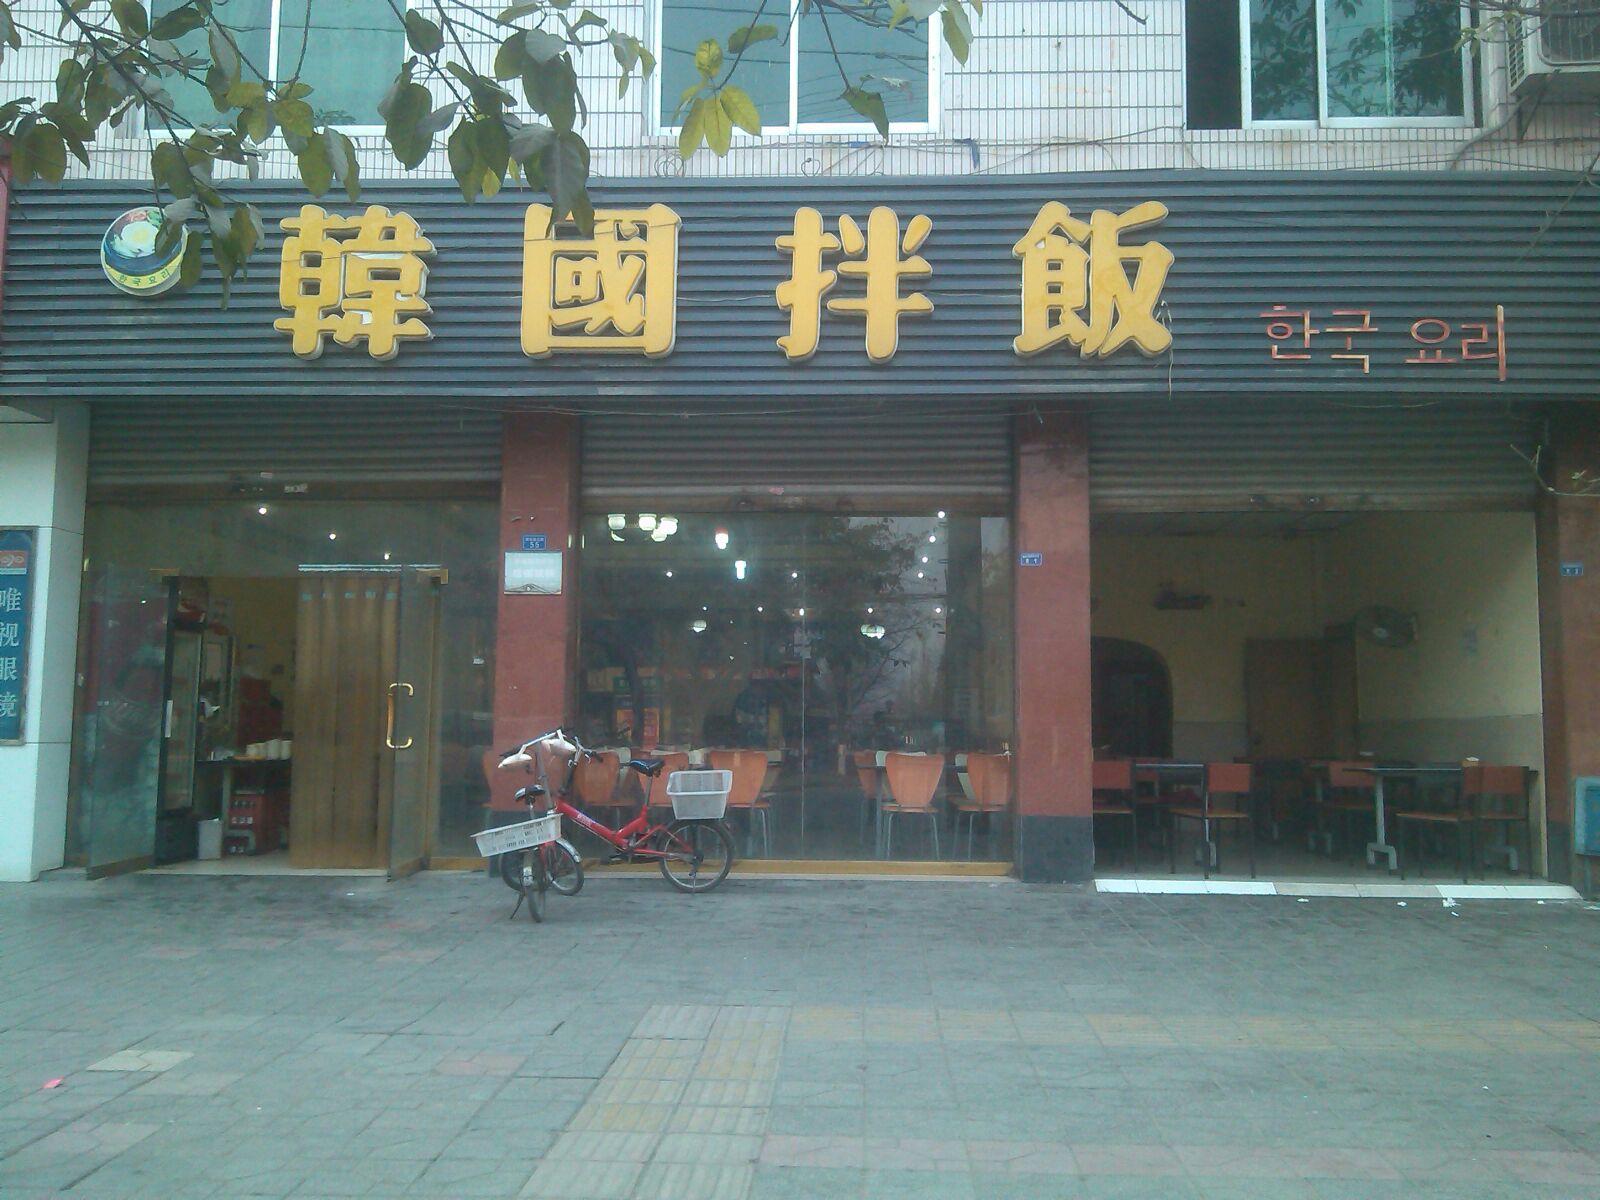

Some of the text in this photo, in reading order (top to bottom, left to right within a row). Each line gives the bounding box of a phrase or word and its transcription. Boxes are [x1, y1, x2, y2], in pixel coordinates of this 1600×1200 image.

[273, 200, 1176, 363] 韓國拌飯
[1259, 303, 1507, 382] 한국 요리
